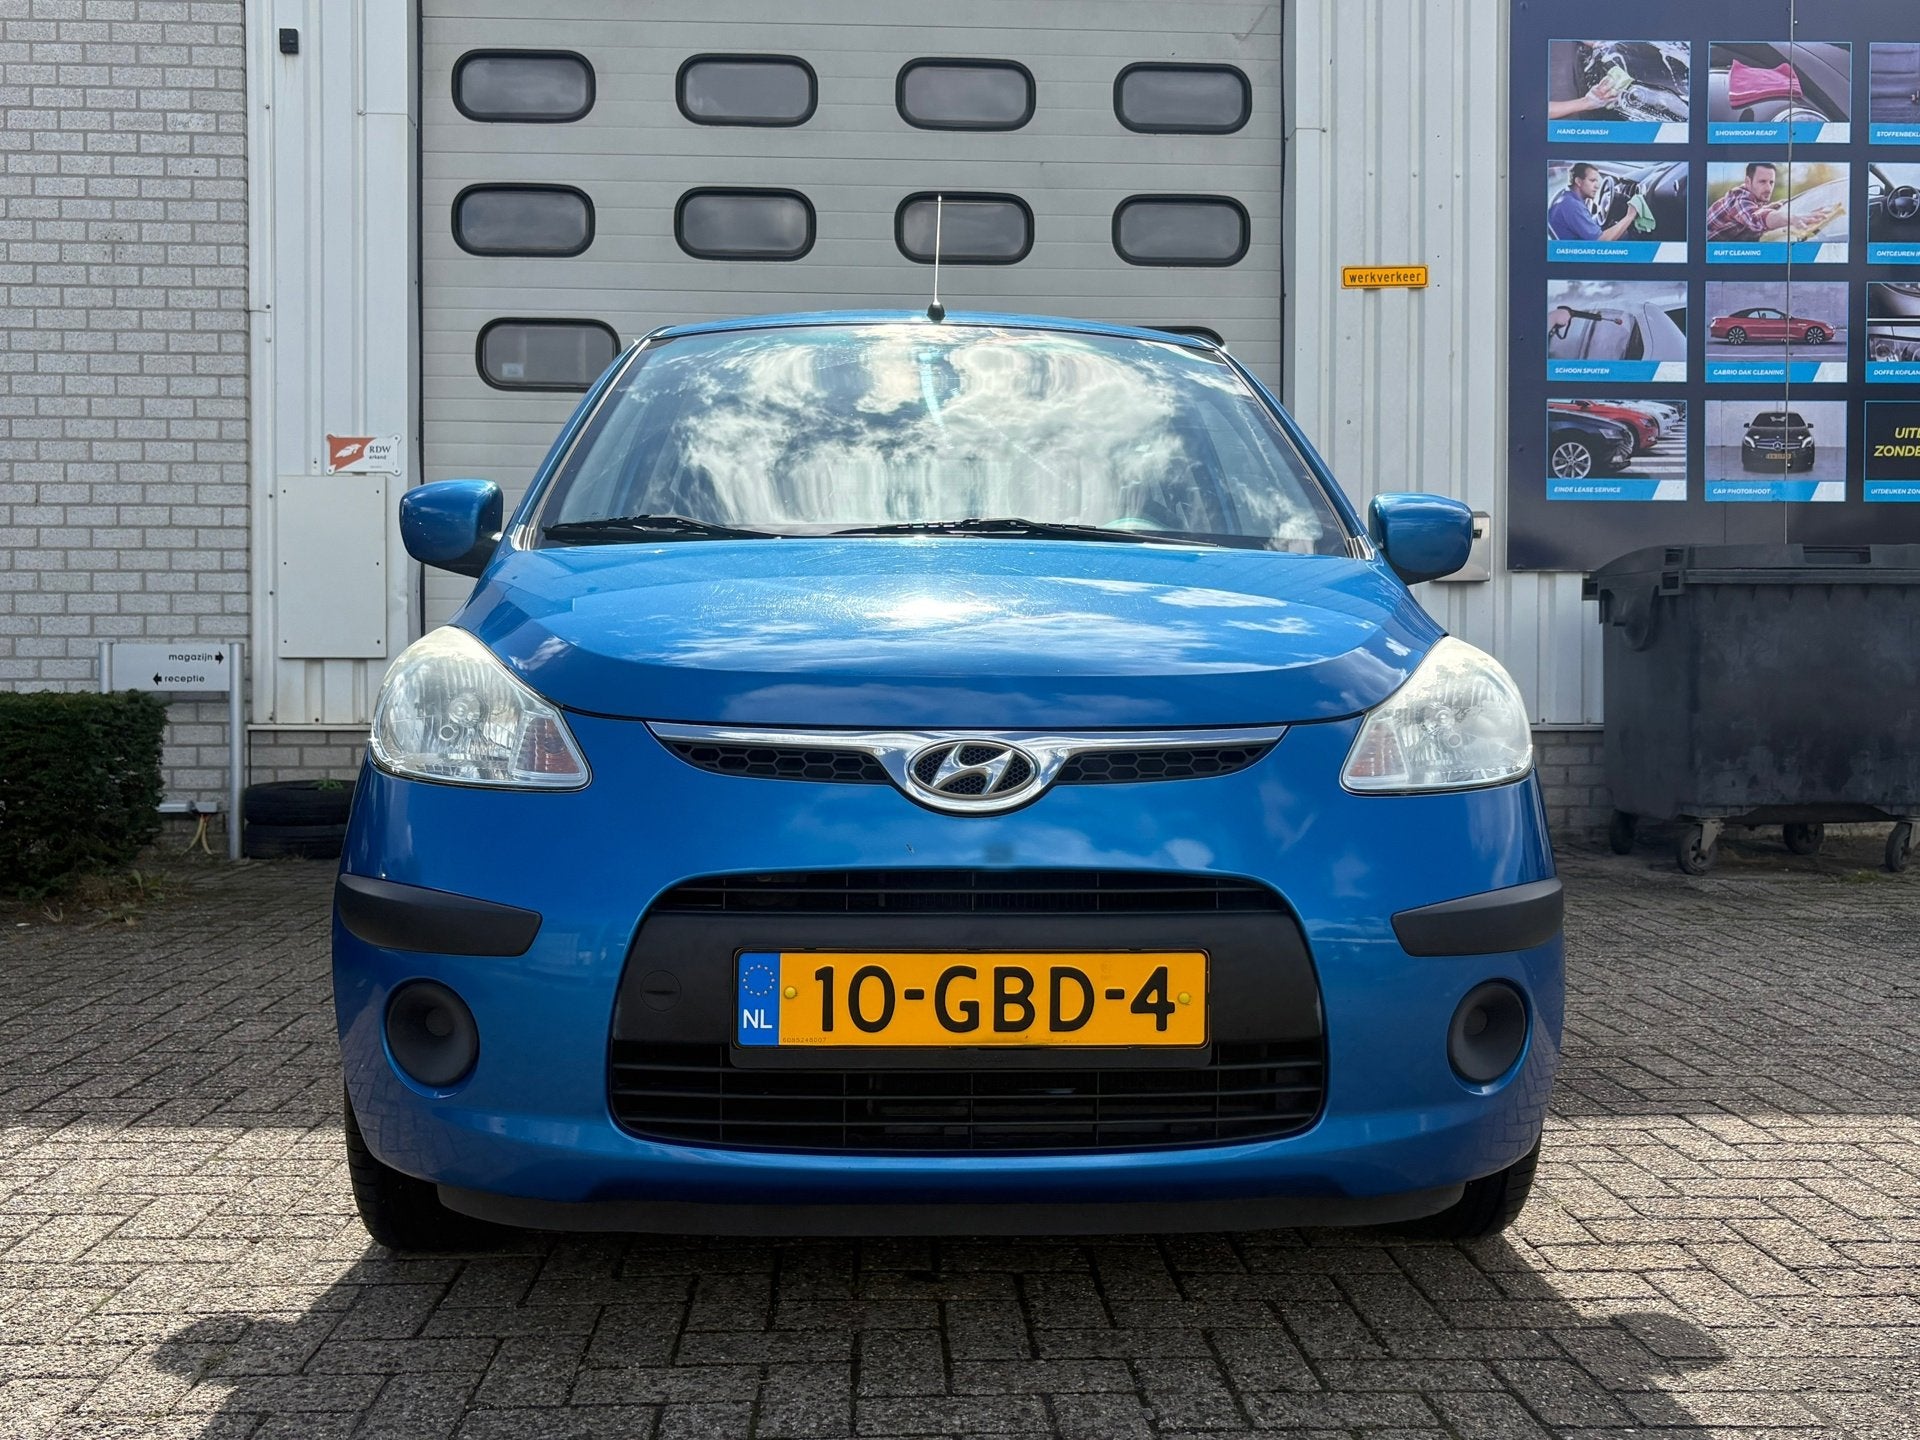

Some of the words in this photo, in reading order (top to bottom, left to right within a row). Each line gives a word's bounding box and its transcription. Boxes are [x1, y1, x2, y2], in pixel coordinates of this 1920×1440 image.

[1349, 271, 1421, 283] werkverkeer
[168, 653, 213, 662] magazijn
[164, 674, 205, 683] receptie
[814, 964, 1176, 1033] 10-GBD-4
[742, 1008, 773, 1029] NL
